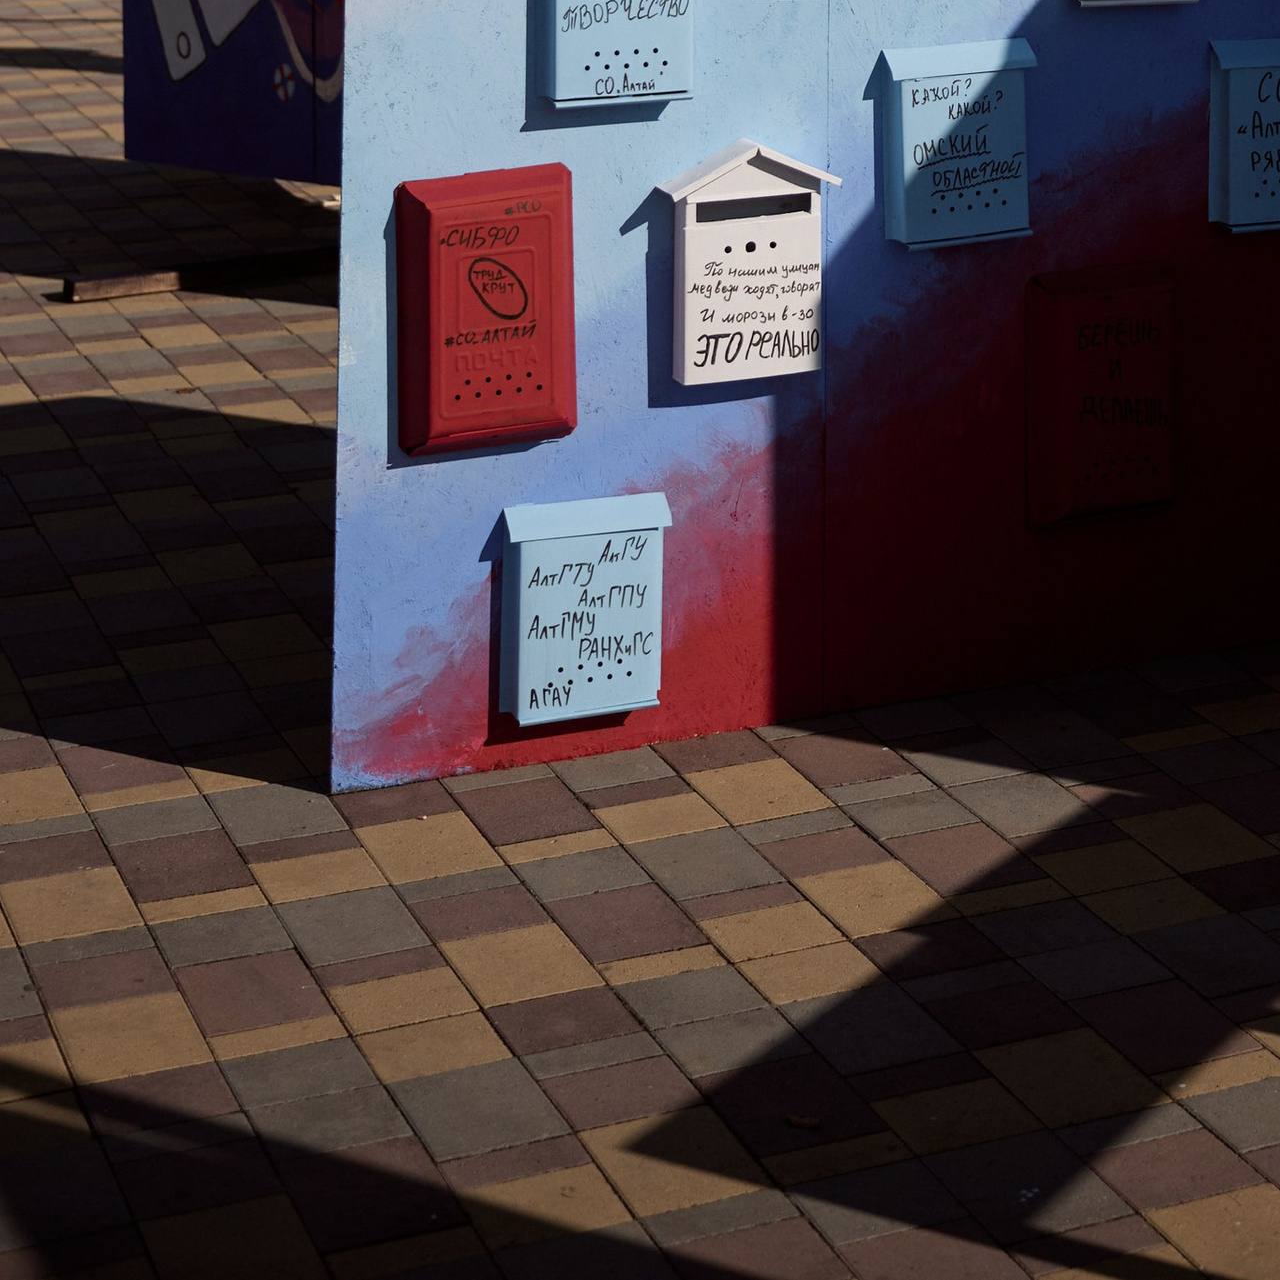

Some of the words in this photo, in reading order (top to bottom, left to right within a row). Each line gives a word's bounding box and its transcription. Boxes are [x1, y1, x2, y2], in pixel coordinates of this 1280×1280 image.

[912, 78, 972, 107] КАКОЙ?
[948, 90, 1003, 120] КАКОЙ?
[914, 125, 988, 165] ОМСКИЙ
[932, 152, 1026, 189] ОБЛАСТНОЙ
[474, 269, 506, 281] ТРУД
[704, 262, 724, 277] По
[728, 266, 778, 277] нашим
[782, 263, 820, 279] улицам
[482, 281, 516, 294] КРУТ
[687, 283, 739, 301] медведи
[780, 281, 821, 294] говорят
[700, 309, 714, 322] И
[722, 309, 776, 324] морозы
[782, 306, 788, 320] в
[1078, 317, 1161, 350] БЕРЁШЬ
[455, 345, 539, 372] ПОЧТА
[693, 332, 743, 367] ЭТО
[745, 328, 819, 360] РЕАЛЬНО
[1108, 357, 1123, 380] И
[1080, 394, 1168, 427] ДЕЛАЕШЬ
[598, 535, 648, 565] АлтГУ
[528, 562, 595, 588] АлтГТУ
[578, 584, 647, 609] АлтГПУ
[528, 611, 596, 640] АлтГМУ
[579, 632, 653, 660] РАНХиГС
[530, 686, 571, 709] АГАУ
